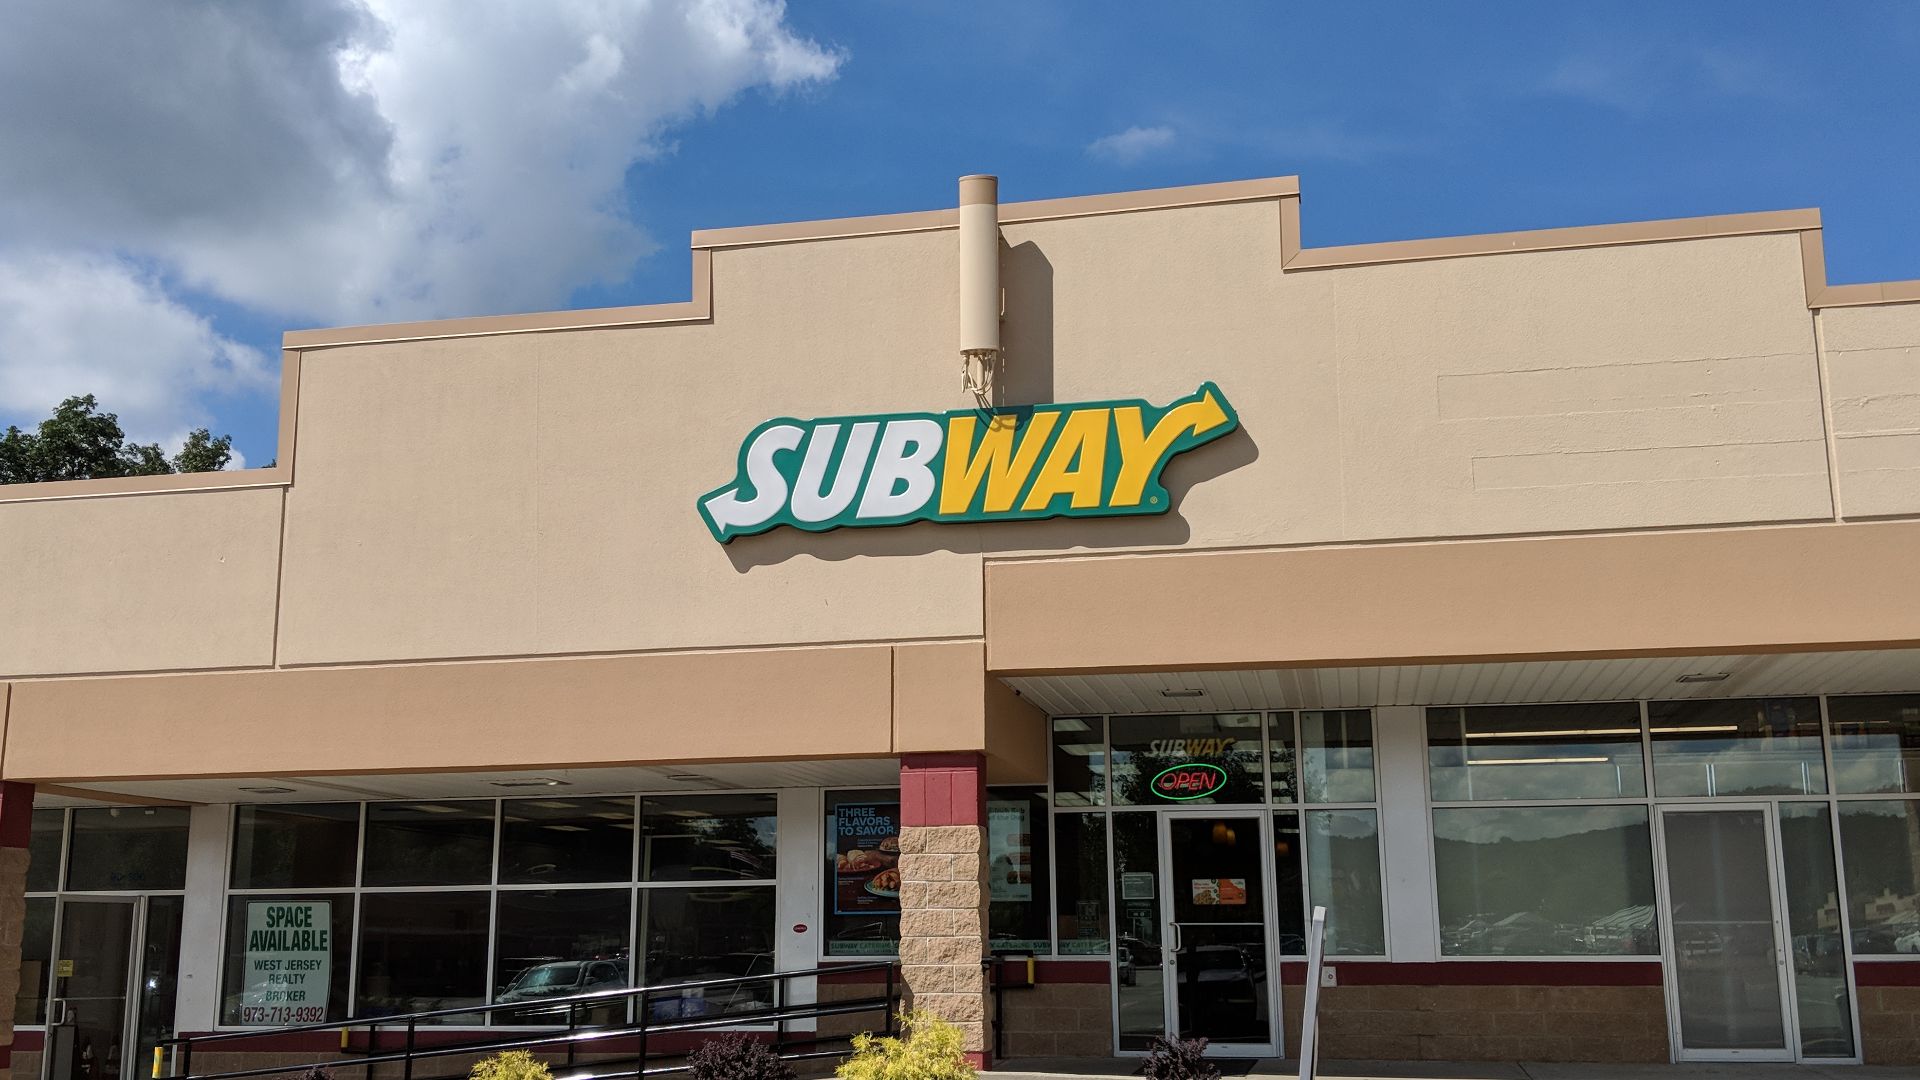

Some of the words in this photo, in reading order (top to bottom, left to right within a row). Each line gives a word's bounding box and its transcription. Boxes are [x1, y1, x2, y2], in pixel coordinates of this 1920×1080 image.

[705, 389, 1228, 534] SUBWAY
[1144, 737, 1236, 757] SUBWAY
[1159, 771, 1217, 791] OPEN
[838, 807, 876, 817] THREE
[838, 816, 891, 827] FLAVORS
[838, 826, 854, 836] TO
[856, 825, 897, 836] SAVOR.
[266, 905, 313, 928] SPACE
[249, 930, 328, 952] AVAILABLE
[254, 960, 282, 970] WEST
[284, 960, 322, 970] JERSEY
[268, 973, 306, 985] REALTY
[265, 990, 306, 1001] BROKER
[243, 1006, 324, 1023] 973-713-9392
